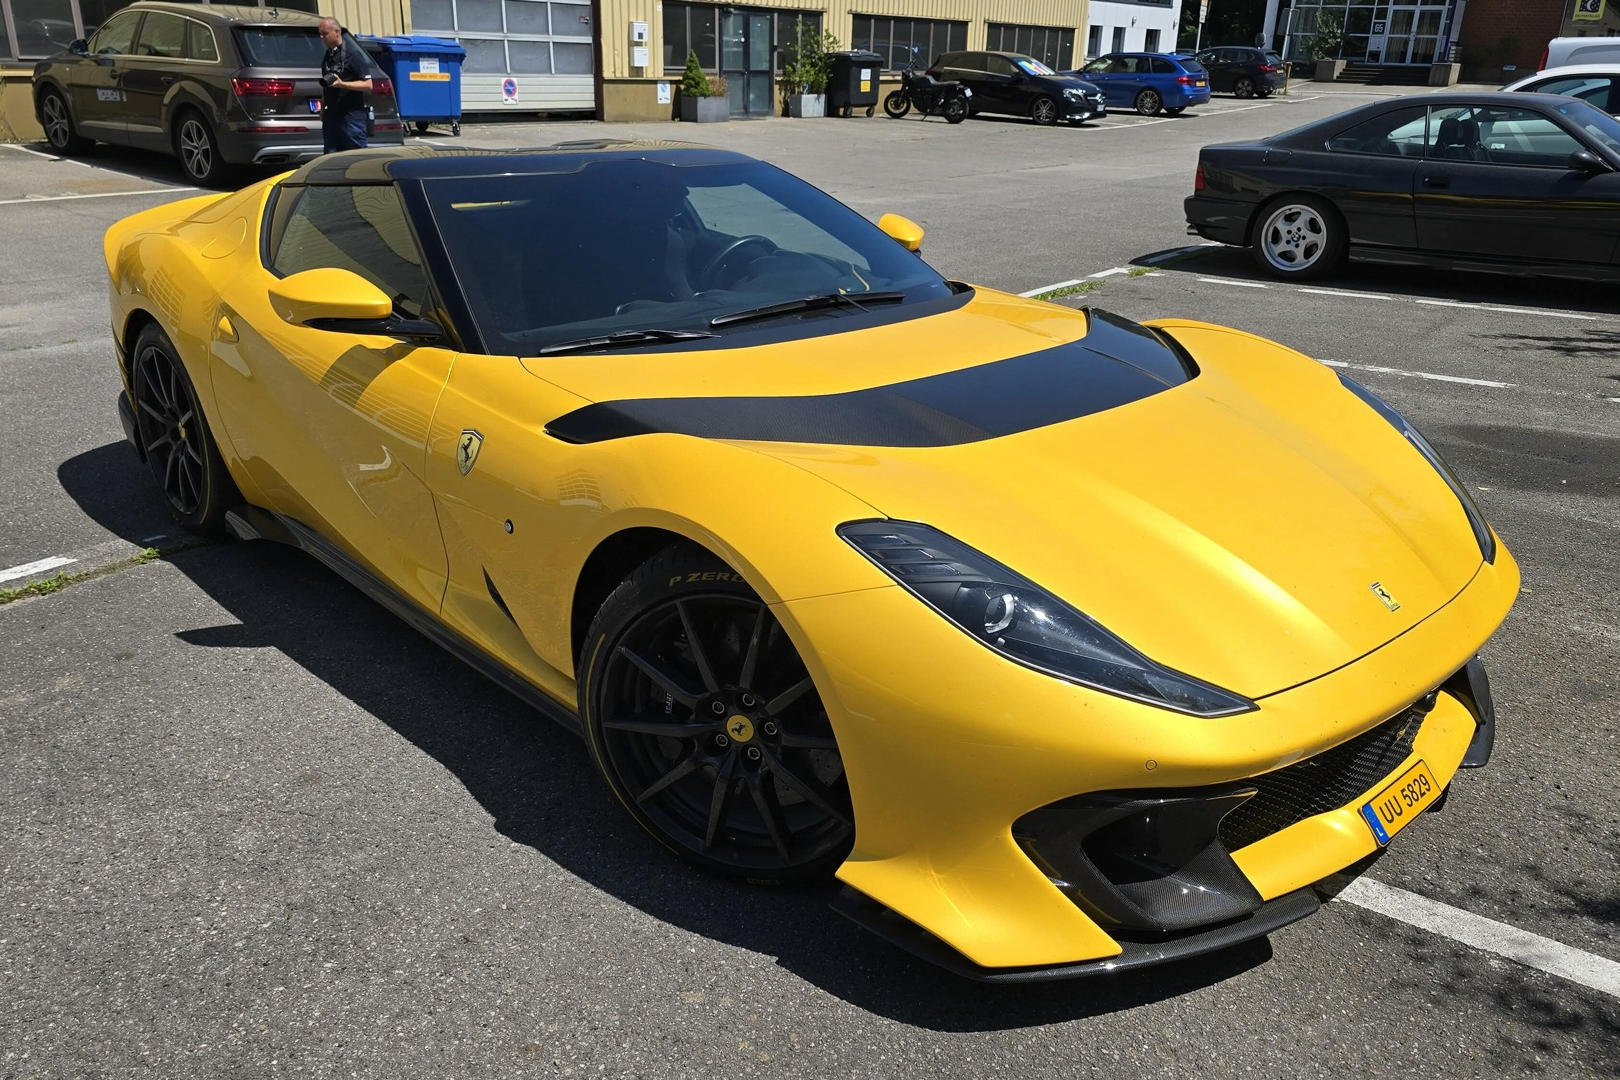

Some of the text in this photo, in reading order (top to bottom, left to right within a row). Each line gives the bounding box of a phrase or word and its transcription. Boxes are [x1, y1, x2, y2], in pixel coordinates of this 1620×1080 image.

[1374, 23, 1384, 33] 65
[668, 575, 682, 587] P
[1379, 773, 1431, 824] UU 5829
[1375, 827, 1384, 837] L
